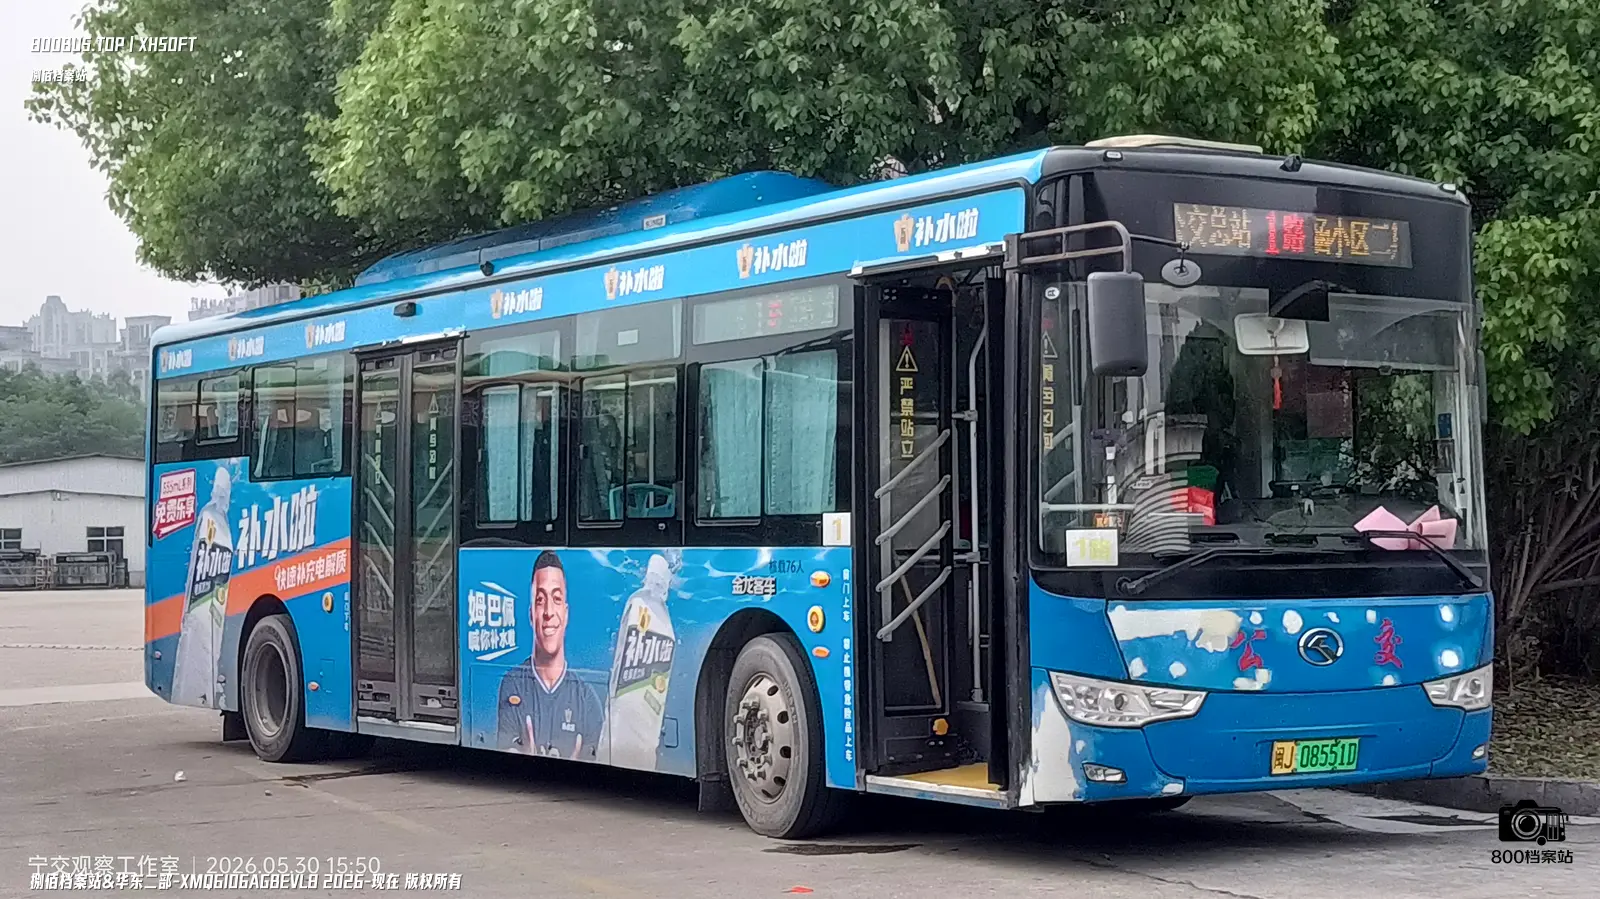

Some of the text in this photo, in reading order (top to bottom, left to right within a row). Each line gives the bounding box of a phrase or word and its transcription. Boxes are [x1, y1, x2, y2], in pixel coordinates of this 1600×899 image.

[914, 207, 979, 247] 补水啦
[752, 238, 808, 275] 补水啦
[619, 264, 665, 297] 补水啦
[503, 287, 544, 316] 补水啦
[899, 377, 914, 458] 严禁站立
[155, 495, 195, 523] 免费乐享
[236, 484, 318, 570] 补水啦
[832, 518, 842, 541] 1
[195, 542, 232, 582] 补水啦
[275, 549, 347, 591] 快速补充电解质
[732, 576, 776, 595] 金龙客车
[468, 588, 515, 627] 姆巴佩
[625, 630, 674, 668] 补水啦
[1375, 617, 1403, 669] 交
